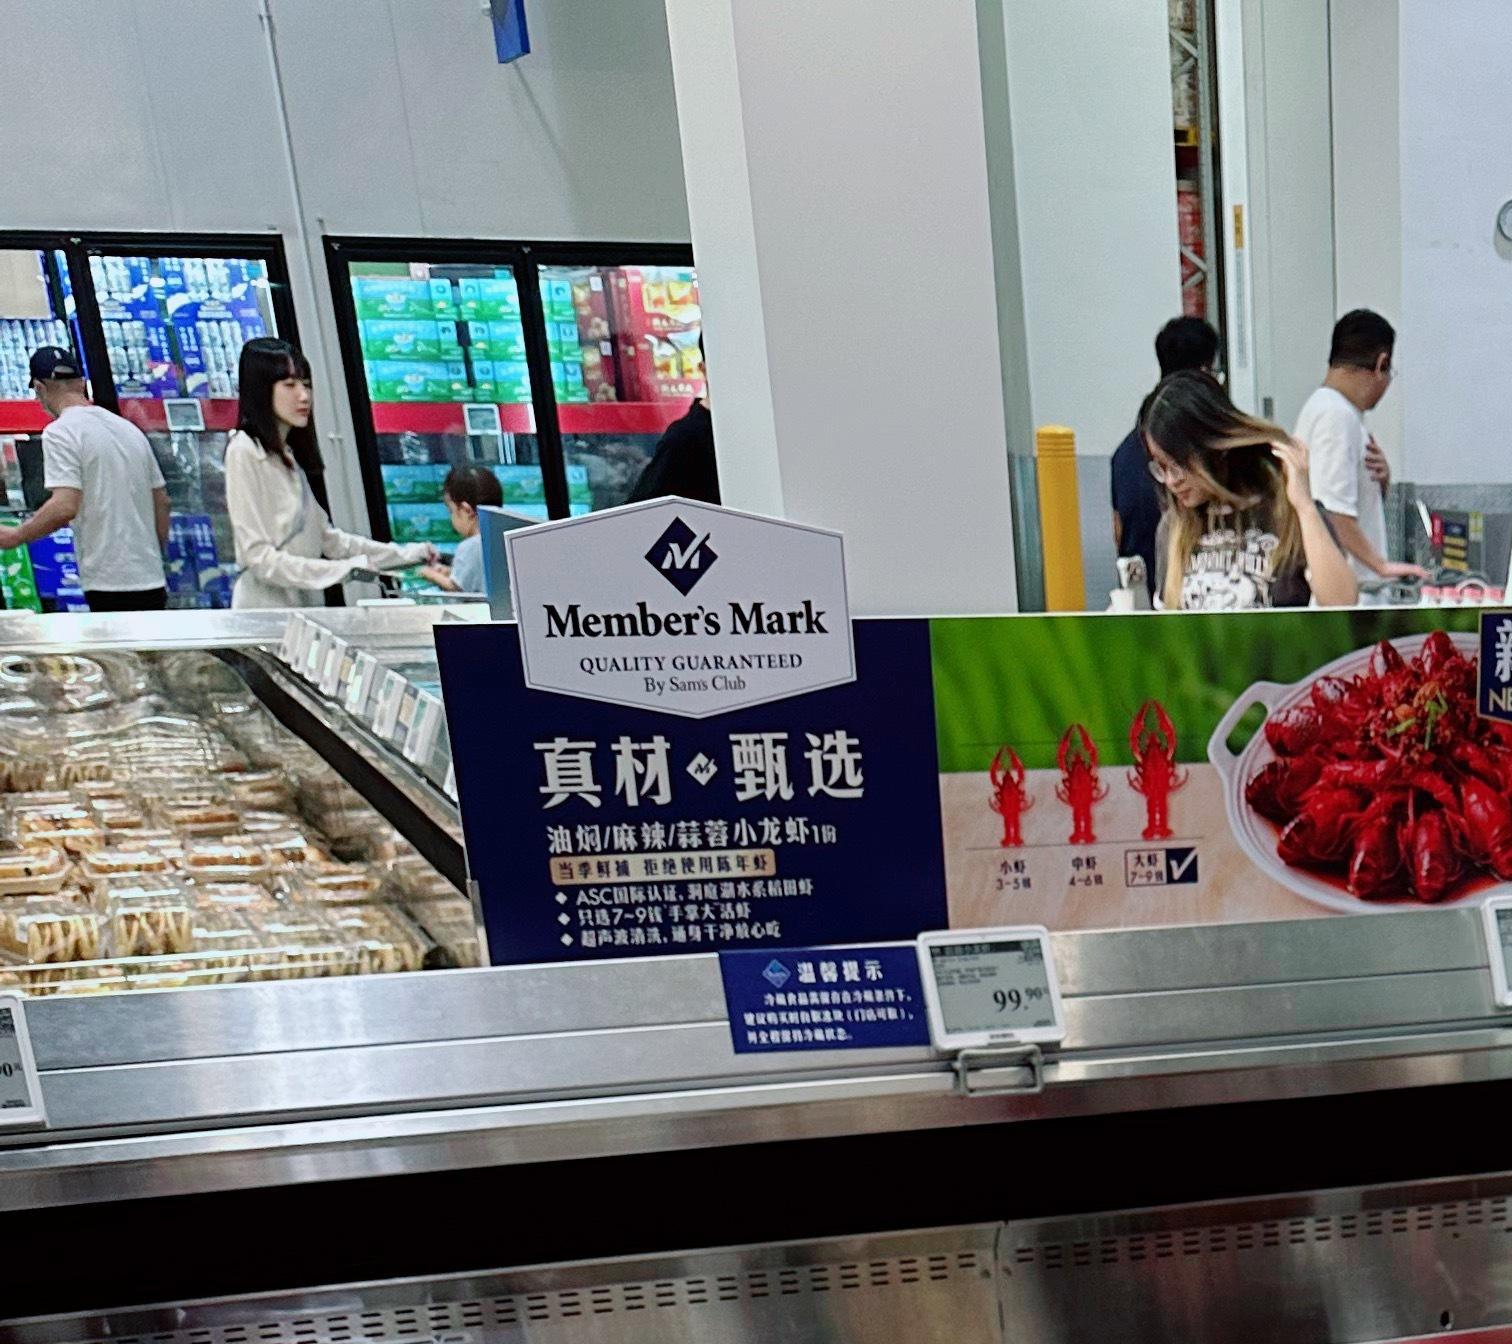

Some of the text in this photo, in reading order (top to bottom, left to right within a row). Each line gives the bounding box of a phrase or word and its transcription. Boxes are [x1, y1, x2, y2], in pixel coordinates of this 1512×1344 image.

[543, 600, 829, 639] Member's Mark
[580, 654, 802, 674] QUALITY GUARANTEED
[643, 675, 746, 695] By Sam's Club
[533, 731, 865, 810] 真材 甄选
